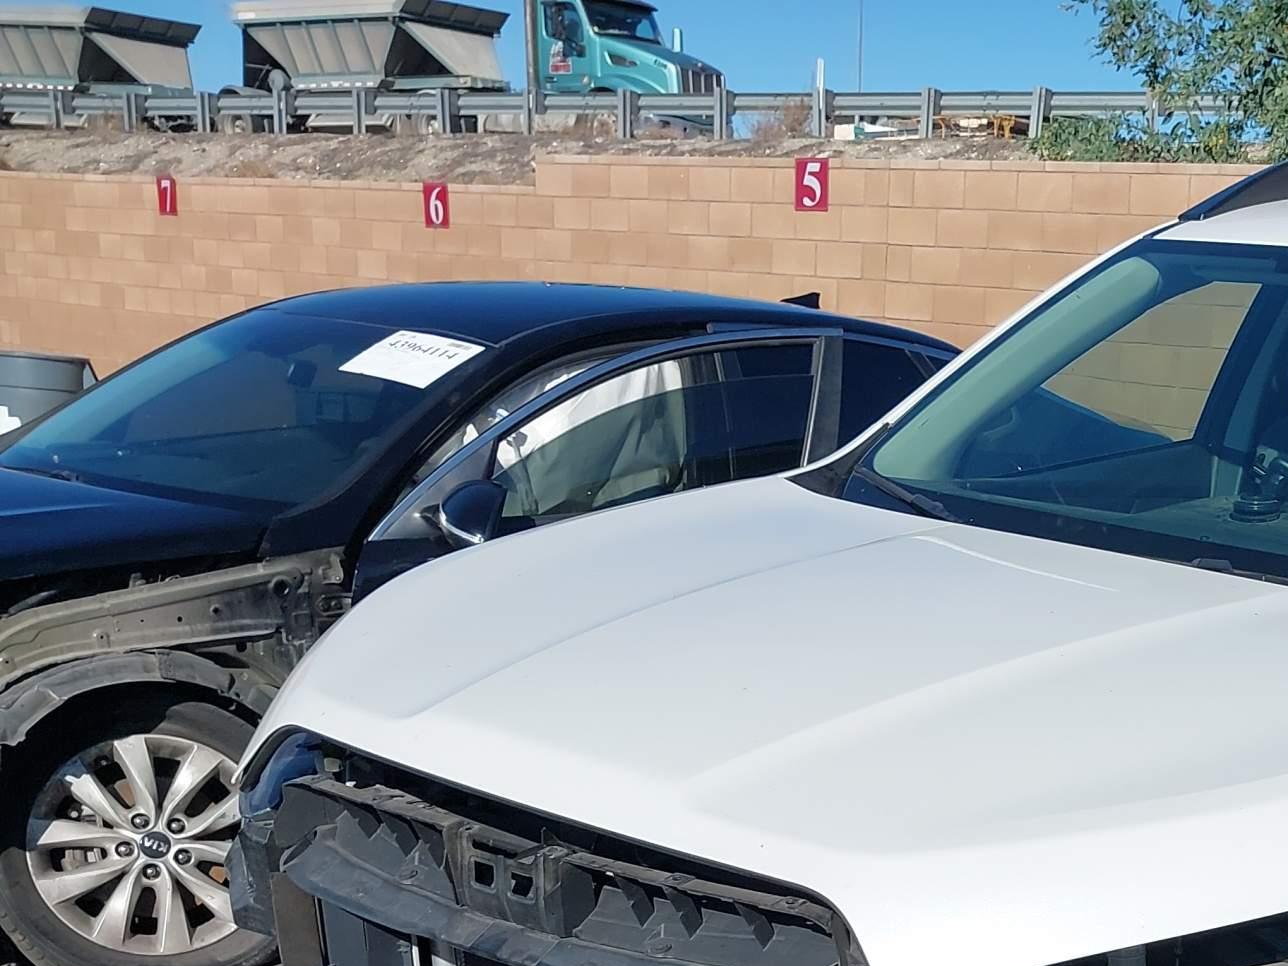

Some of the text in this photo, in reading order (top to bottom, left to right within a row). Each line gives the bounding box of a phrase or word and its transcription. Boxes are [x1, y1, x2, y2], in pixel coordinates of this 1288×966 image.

[160, 179, 171, 214] 7
[802, 162, 822, 207] 5
[429, 186, 444, 225] 6
